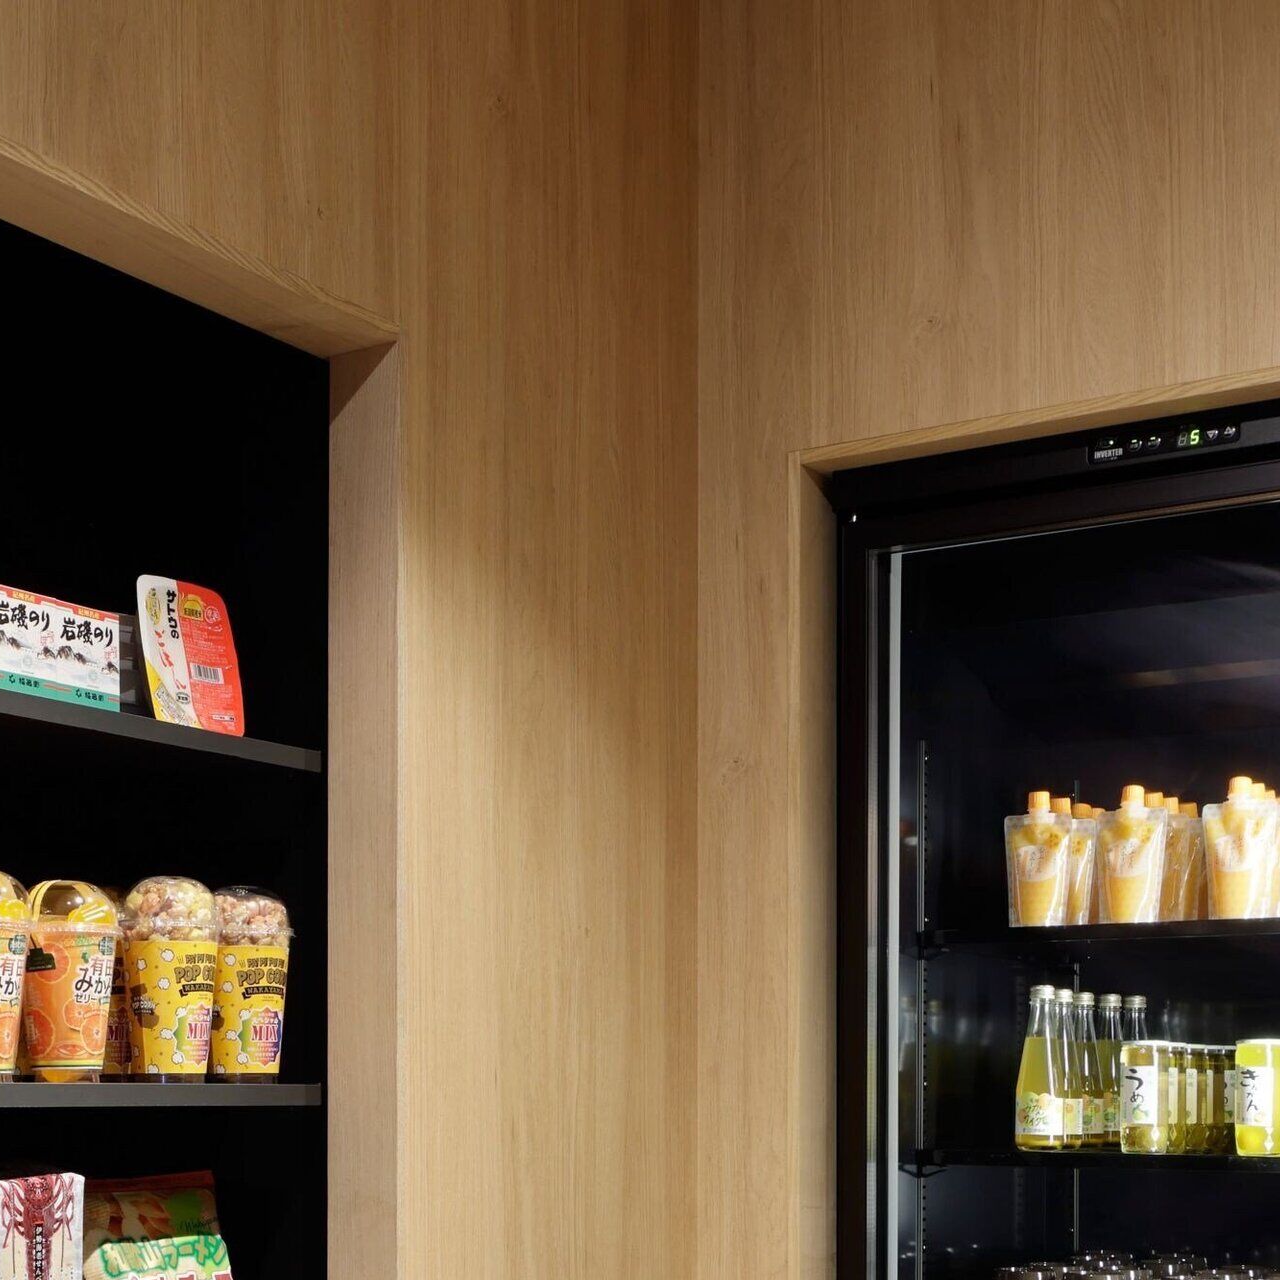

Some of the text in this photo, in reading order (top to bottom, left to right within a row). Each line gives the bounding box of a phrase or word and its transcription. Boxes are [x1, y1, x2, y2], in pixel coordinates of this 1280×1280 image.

[1093, 448, 1123, 459] INVERTER
[60, 617, 114, 648] 岩磯のり
[174, 965, 201, 984] POP
[237, 969, 265, 987] POP
[251, 1025, 279, 1042] MIX
